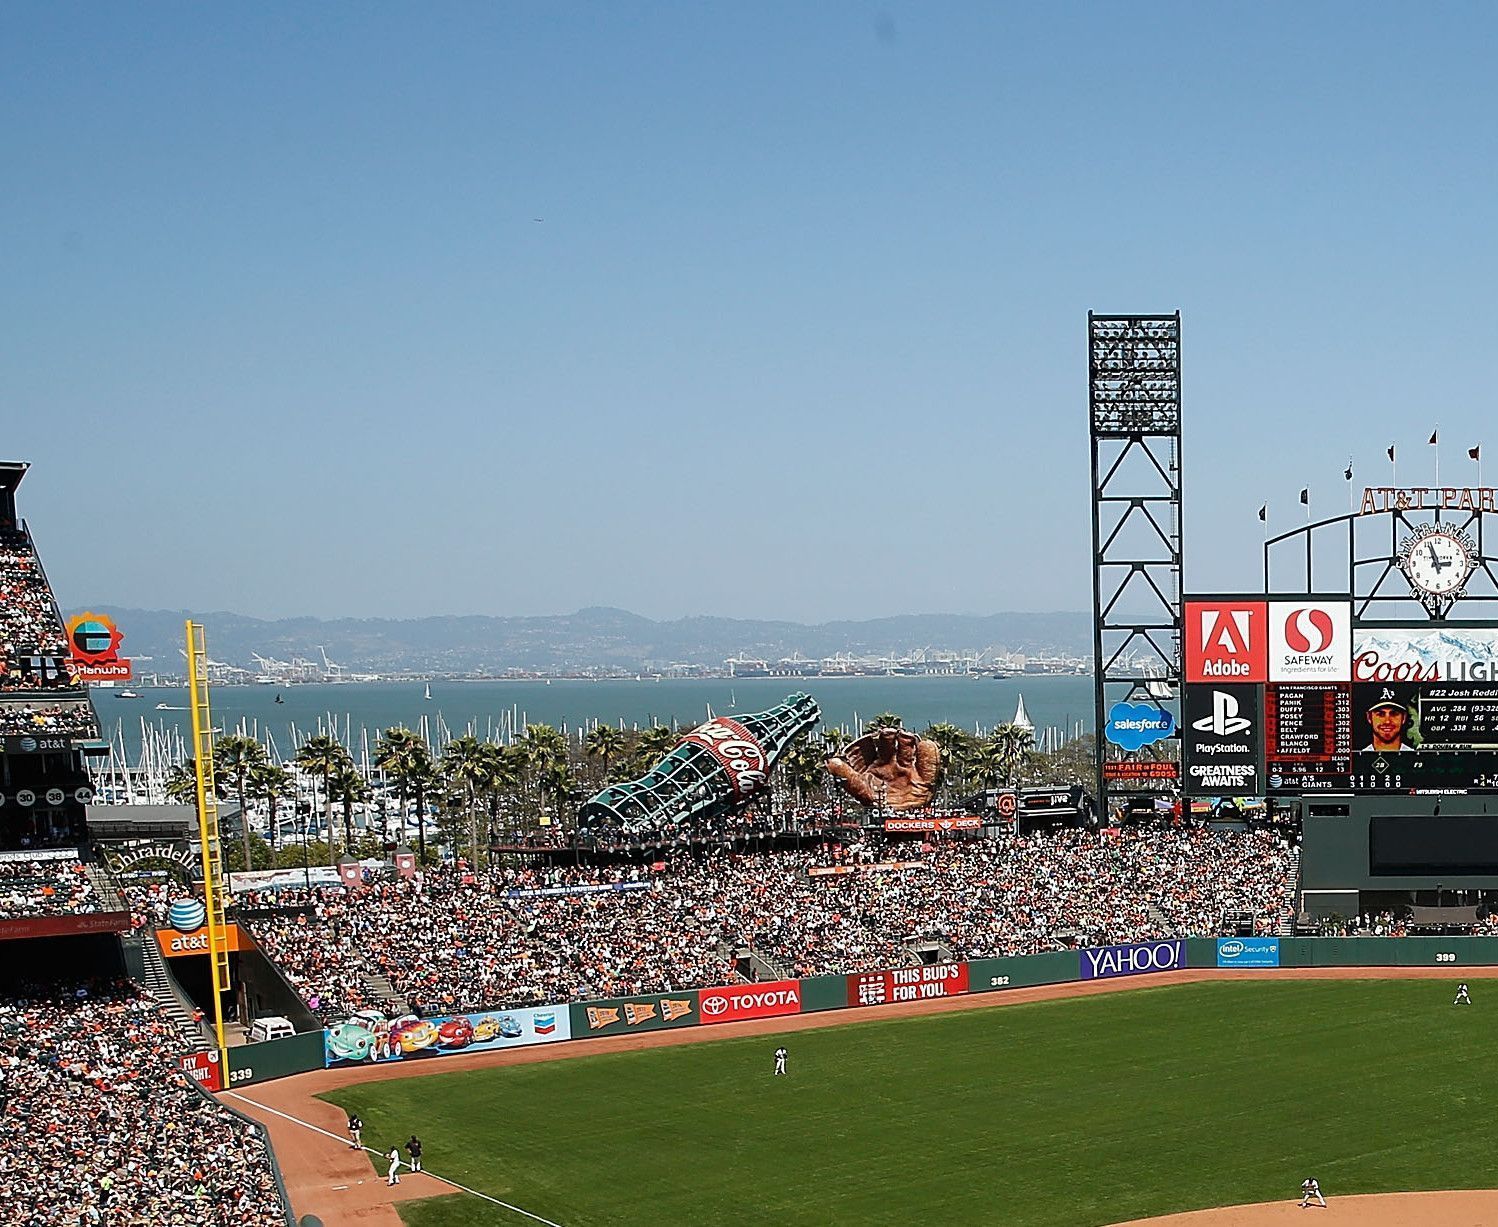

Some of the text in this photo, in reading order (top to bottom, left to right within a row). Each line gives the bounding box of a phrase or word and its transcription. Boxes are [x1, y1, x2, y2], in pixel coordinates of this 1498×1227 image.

[1360, 487, 1428, 515] AT&T
[1395, 521, 1480, 569] SAN FRANCISCO
[1409, 585, 1468, 607] GIANTS
[1284, 655, 1333, 665] SAFEWAY
[1353, 651, 1441, 681] Coors
[77, 665, 128, 675] Hanwha
[1203, 659, 1250, 676] Adobe
[1114, 719, 1168, 732] salesforce
[40, 738, 65, 749] at&t
[1190, 765, 1255, 776] GREATNESS
[1201, 776, 1248, 787] AWAITS.
[20, 794, 32, 802] 30
[77, 791, 90, 799] 44
[956, 819, 979, 827] DECK
[105, 843, 200, 874] Ghirardelli
[171, 934, 209, 950] at&t
[1222, 944, 1240, 953] intel
[1085, 941, 1180, 976] YAHOO!
[1436, 953, 1456, 963] 399
[891, 964, 958, 985] THIS BUD'S
[991, 976, 1009, 986] 382
[892, 982, 947, 1001] FOR YOU.
[730, 991, 798, 1010] TOYOTA
[183, 1057, 197, 1071] FLY
[230, 1068, 253, 1082] 339
